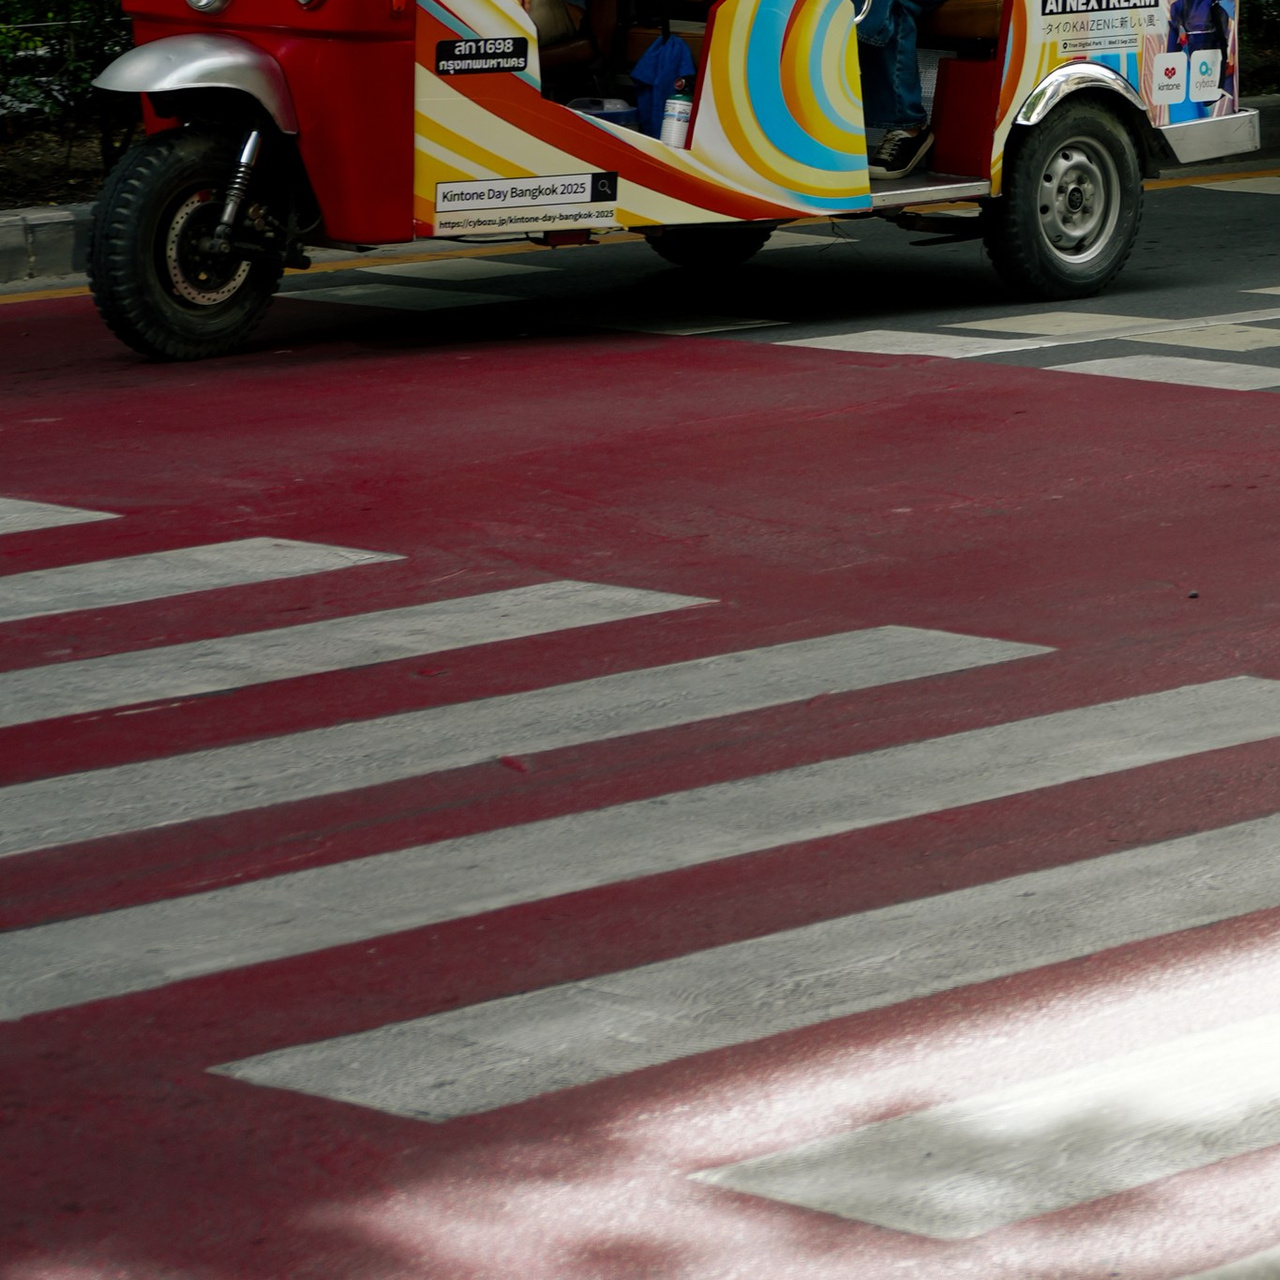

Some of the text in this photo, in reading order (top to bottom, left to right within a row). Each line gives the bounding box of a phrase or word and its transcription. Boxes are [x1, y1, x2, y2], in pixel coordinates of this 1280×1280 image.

[454, 39, 513, 55] สก 1698
[438, 58, 525, 75] กรุงเทพมหานคร
[1158, 82, 1181, 91] kintone
[442, 183, 586, 203] Kintone Day Bangkok 2025
[439, 210, 614, 230] https://cybozu.jp/kintone-day-bangkok-2025
